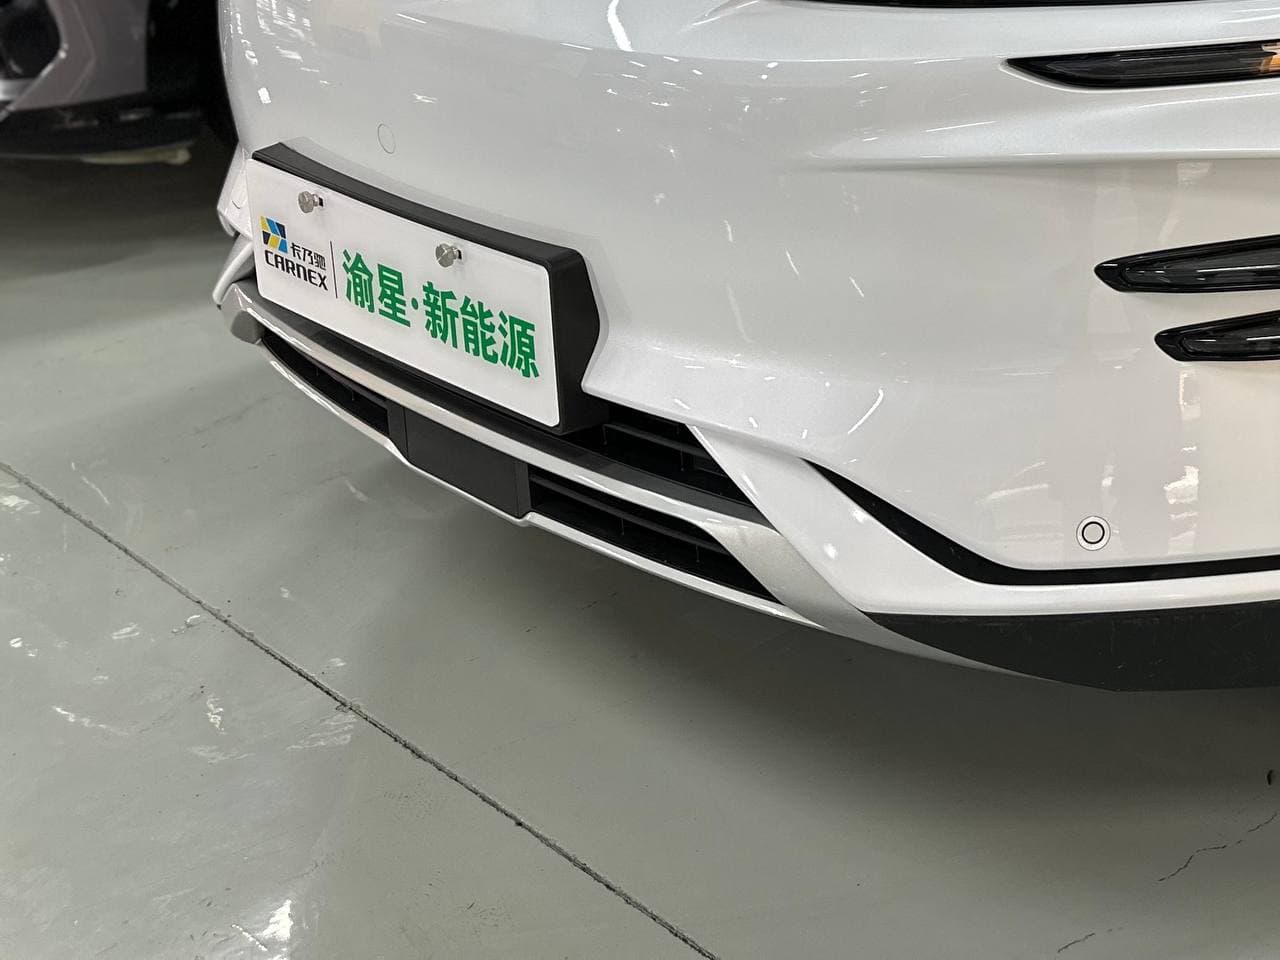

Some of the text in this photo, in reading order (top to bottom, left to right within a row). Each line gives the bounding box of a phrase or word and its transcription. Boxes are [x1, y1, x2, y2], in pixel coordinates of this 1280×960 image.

[265, 249, 329, 291] CARNEX
[290, 242, 327, 271] 卡乃驰
[342, 249, 540, 378] 渝星·新能源
